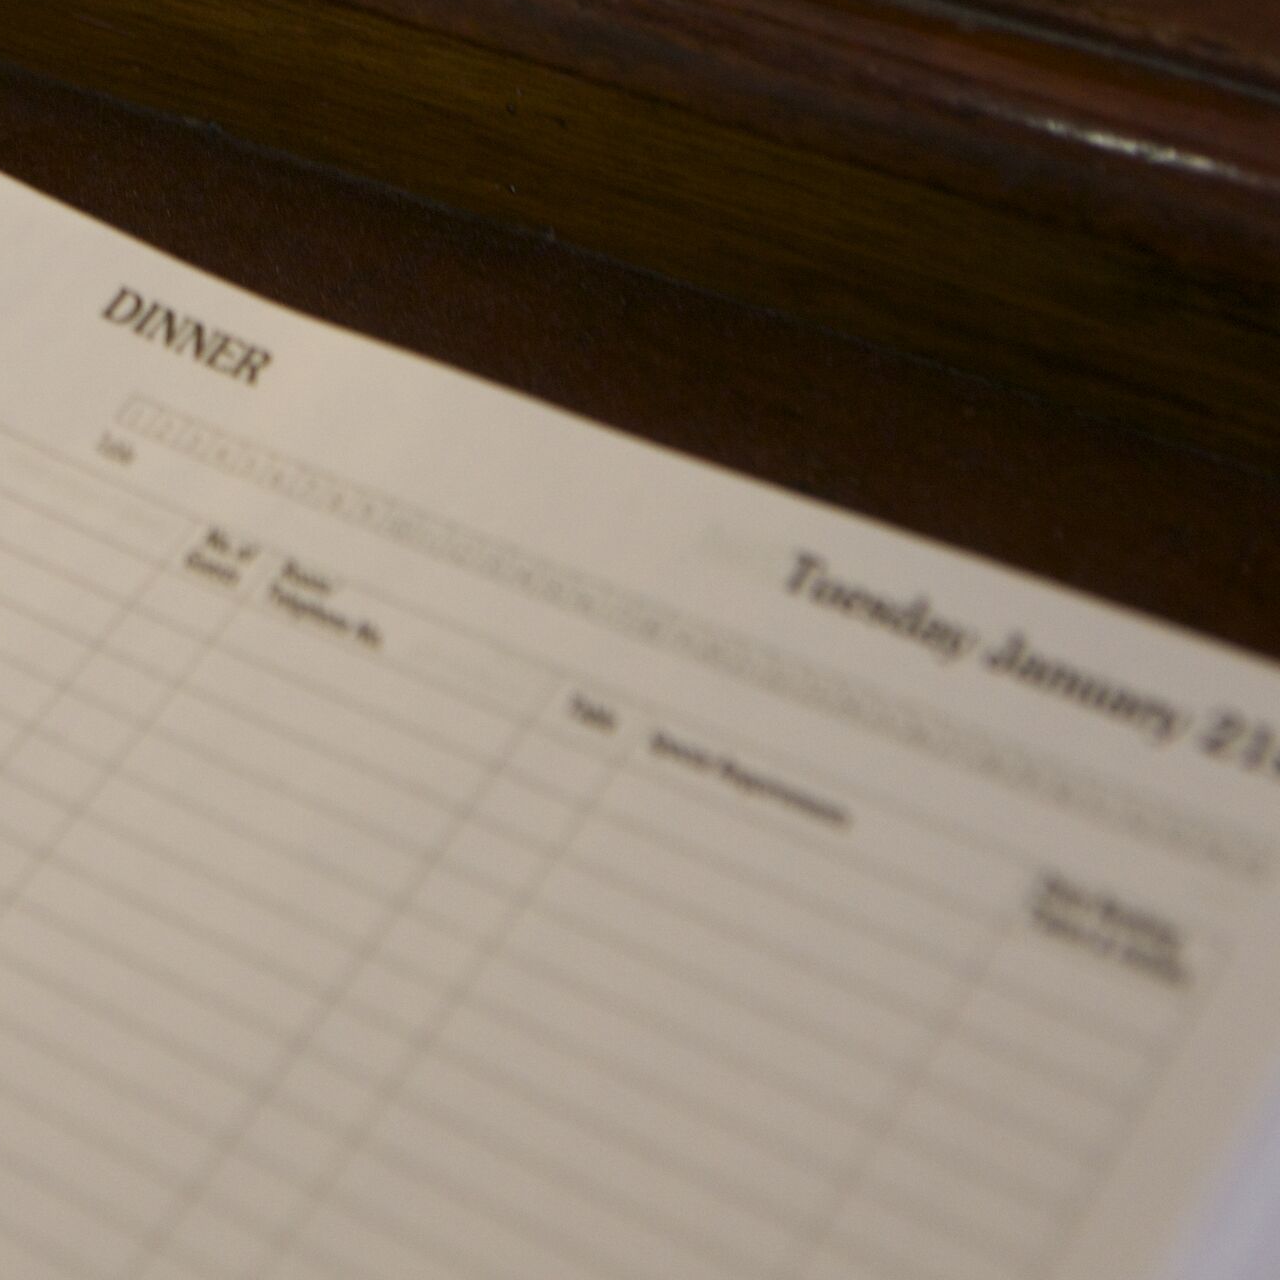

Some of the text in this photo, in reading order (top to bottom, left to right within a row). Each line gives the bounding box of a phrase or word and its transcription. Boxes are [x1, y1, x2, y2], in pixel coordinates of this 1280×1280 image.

[100, 285, 273, 388] DINNER
[786, 549, 980, 666] Tuesday
[982, 629, 1192, 745] January
[1200, 706, 1280, 782] 21
